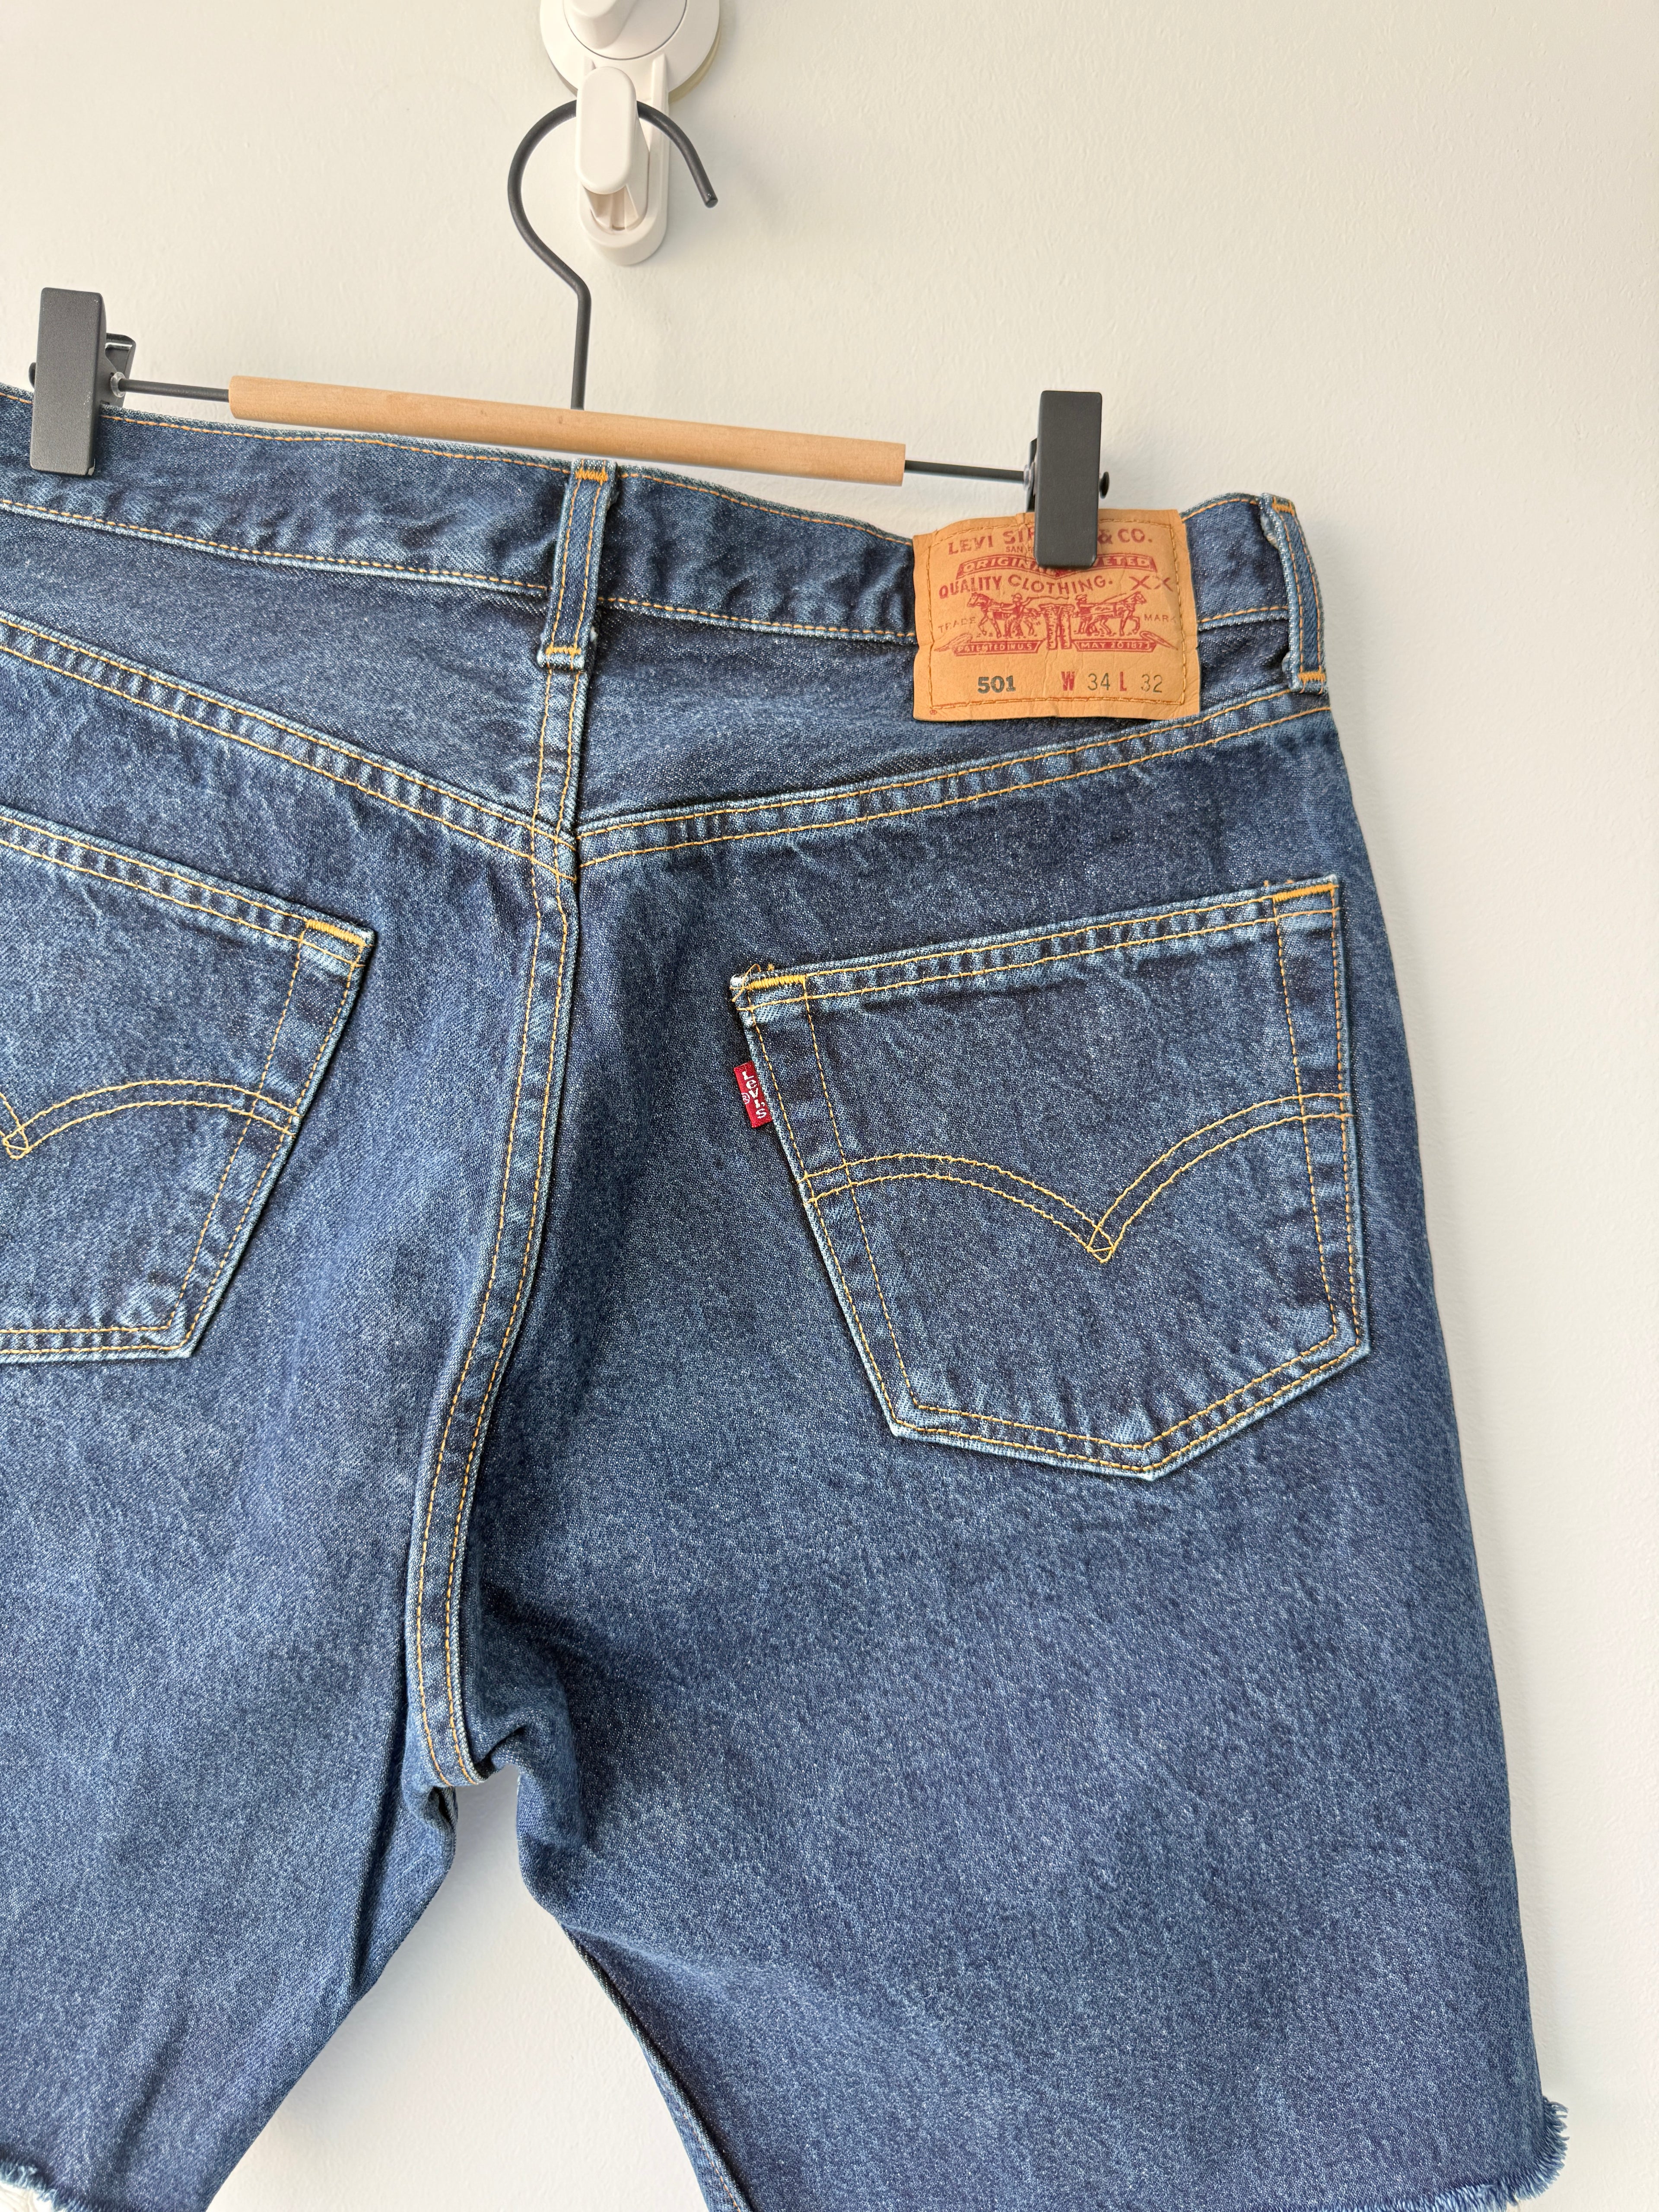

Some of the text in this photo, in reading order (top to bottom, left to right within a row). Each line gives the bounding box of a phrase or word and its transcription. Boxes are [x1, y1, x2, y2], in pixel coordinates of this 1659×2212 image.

[948, 535, 993, 555] LEVI
[1118, 528, 1153, 543] CO.
[939, 575, 1002, 599] QUALITY
[938, 617, 976, 633] TRADE
[957, 643, 1005, 652] PATENTED
[977, 675, 1016, 694] 501
[1061, 671, 1163, 693] W 34 L 32
